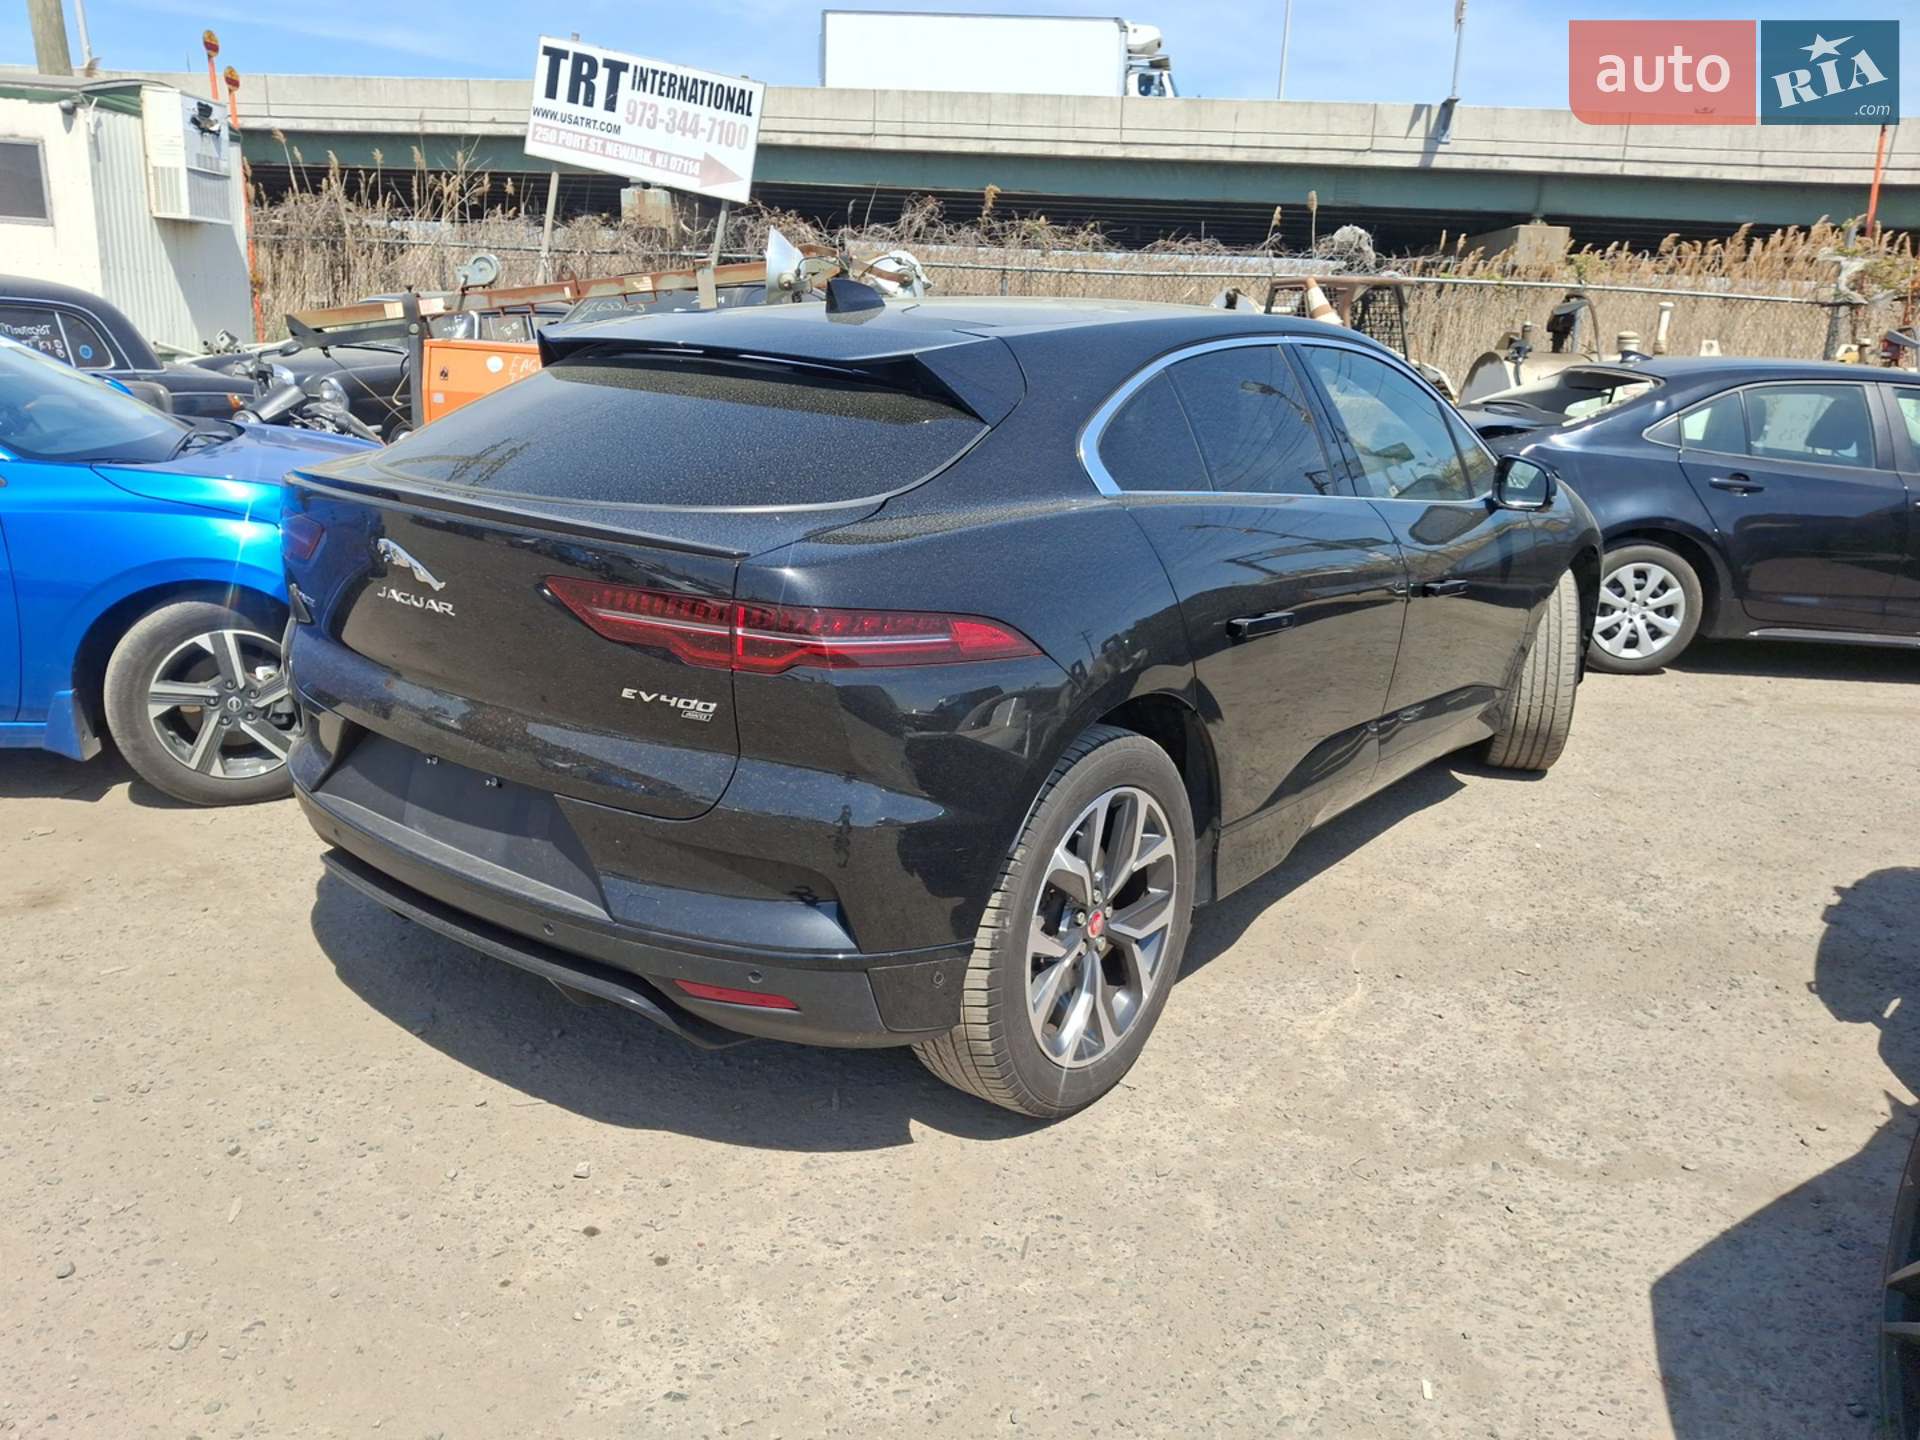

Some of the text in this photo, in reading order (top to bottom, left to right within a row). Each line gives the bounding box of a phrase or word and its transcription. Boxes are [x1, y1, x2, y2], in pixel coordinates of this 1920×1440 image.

[542, 45, 754, 117] TRT INTERNATIONAL
[532, 106, 621, 136] WWW.USATRT.COM
[625, 98, 749, 150] 973-344-7100
[534, 126, 557, 143] 250
[557, 131, 587, 151] PORT
[655, 153, 668, 169] NJ
[669, 157, 700, 178] 07114
[376, 586, 455, 617] JAGUAR
[621, 687, 717, 713] EV400
